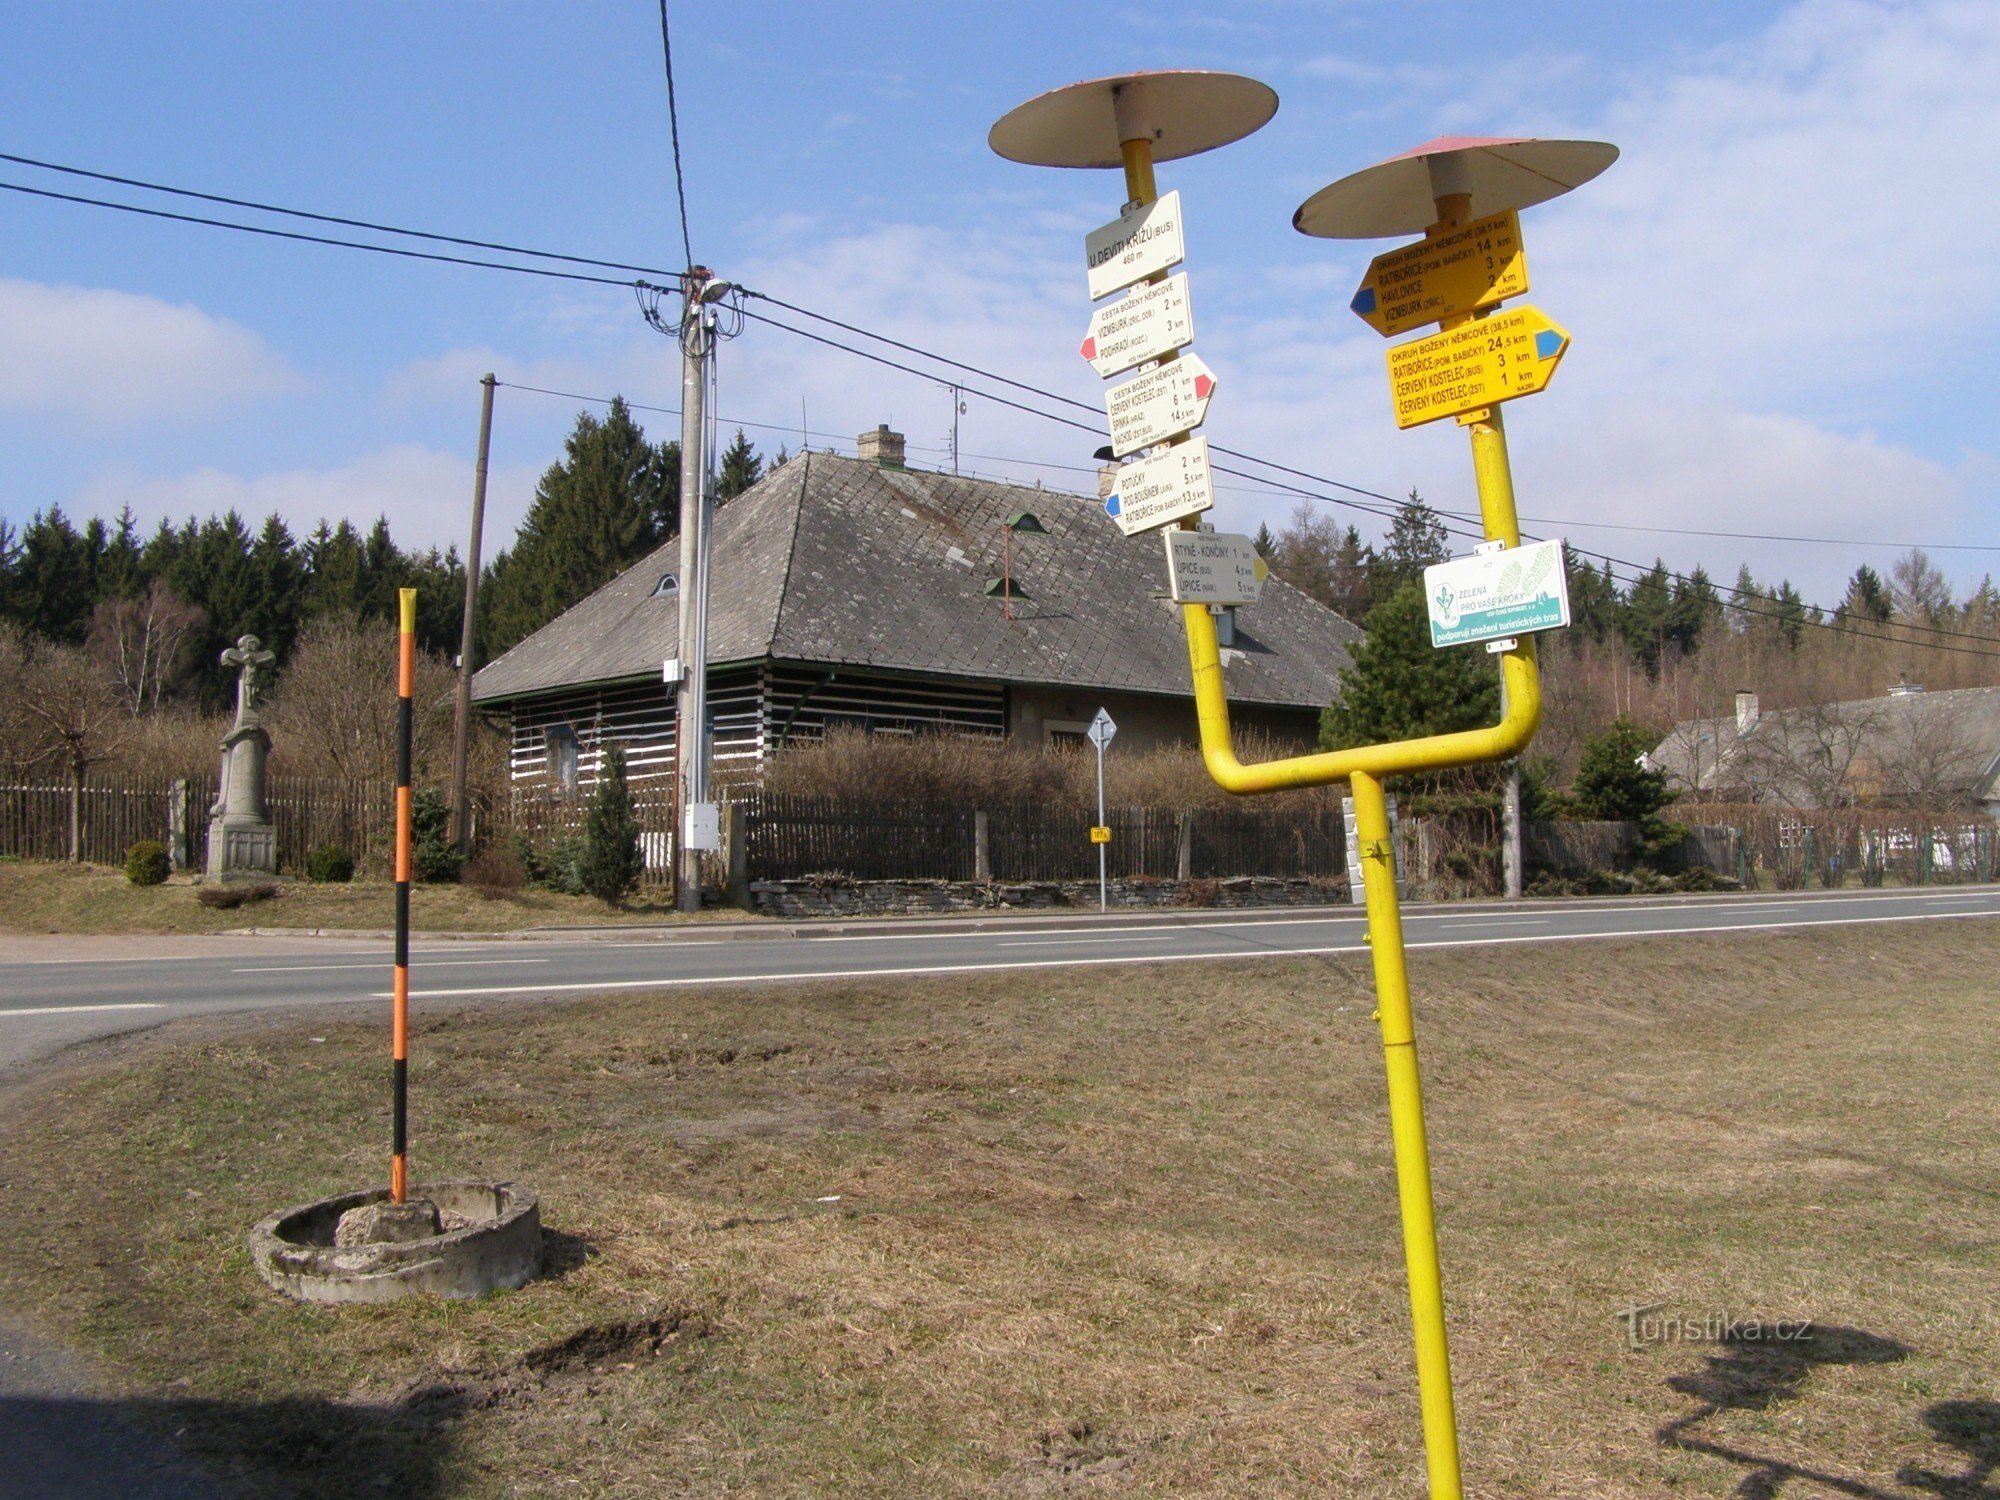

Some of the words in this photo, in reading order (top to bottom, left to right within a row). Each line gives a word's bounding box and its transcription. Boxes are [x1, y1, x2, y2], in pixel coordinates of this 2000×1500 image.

[1089, 255, 1096, 267] U
[1098, 239, 1125, 265] DEVÍTI
[1126, 224, 1153, 251] KŘÍŽŮ
[1153, 220, 1174, 239] (BUS)
[1123, 254, 1135, 265] 460
[1136, 251, 1143, 259] m
[1377, 258, 1403, 271] OKRUH
[1403, 245, 1434, 260] BOŽENY
[1436, 227, 1474, 251] NĚMCOVÉ
[1493, 216, 1509, 230] km)
[1378, 261, 1423, 288] RATIBOŘICE
[1442, 247, 1474, 266] BABIČKY)
[1477, 238, 1491, 254] 14
[1497, 236, 1511, 248] km
[1381, 279, 1423, 305] HAVLOVICE
[1486, 256, 1494, 270] 3
[1500, 255, 1513, 266] km
[1101, 308, 1119, 321] CESTA
[1120, 297, 1143, 312] BOŽENY
[1144, 282, 1174, 301] NĚMCOVÉ
[1384, 298, 1423, 322] VIZMBURK
[1488, 274, 1496, 288] 2
[1502, 273, 1516, 284] km
[1097, 317, 1127, 339] VIZMBURK
[1164, 298, 1170, 311] 2
[1172, 298, 1182, 307] km
[1100, 336, 1129, 360] PODHRADÍ
[1167, 320, 1173, 332] 3
[1174, 320, 1184, 329] km
[1392, 347, 1418, 363] OKRUH
[1419, 338, 1450, 355] BOŽENY
[1451, 325, 1489, 344] NĚMCOVÉ
[1490, 319, 1509, 335] (38,5
[1509, 315, 1525, 327] km)
[1393, 356, 1434, 381] RATIBOŘICE
[1434, 356, 1452, 371] (POM.
[1453, 345, 1486, 363] BABIČKY)
[1487, 336, 1512, 353] 24,5
[1513, 334, 1527, 345] km
[1396, 374, 1428, 398] ČERVENÝ
[1429, 365, 1465, 388] KOSTELEC
[1465, 364, 1484, 379] (BUS)
[1497, 353, 1506, 368] 3
[1516, 352, 1530, 363] km
[1114, 387, 1131, 401] CESTA
[1132, 377, 1154, 392] BOŽENY
[1155, 362, 1183, 381] NĚMCOVÉ
[1131, 387, 1156, 407] KOSTELEC
[1172, 379, 1176, 390] 1
[1182, 377, 1191, 385] km
[1173, 394, 1179, 406] 6
[1184, 393, 1193, 401] km
[1399, 391, 1431, 415] ČERVENÝ
[1431, 384, 1467, 406] KOSTELEC
[1468, 382, 1486, 397] (ŽST)
[1502, 372, 1508, 386] 1
[1519, 371, 1533, 382] km
[1171, 410, 1185, 422] 14,5
[1185, 409, 1195, 417] km
[1182, 456, 1187, 468] 2
[1192, 455, 1202, 463] km
[1123, 494, 1134, 507] POD
[1184, 473, 1194, 485] 5,5
[1194, 473, 1204, 481] km
[1125, 503, 1154, 524] RATIBOŘICE
[1197, 490, 1206, 498] km
[1174, 543, 1197, 557] RTYNĚ
[1233, 548, 1238, 559] 1
[1176, 560, 1199, 575] ÚPICE
[1235, 564, 1245, 576] 4,5
[1180, 578, 1202, 592] ÚPICE
[1459, 586, 1487, 600] ZELENÁ
[1461, 601, 1476, 612] PRO
[1477, 596, 1497, 610] VAŠE
[1498, 592, 1524, 608] KROKY
[1471, 624, 1498, 636] značení
[1498, 615, 1542, 631] turistických
[1543, 612, 1559, 622] tras
